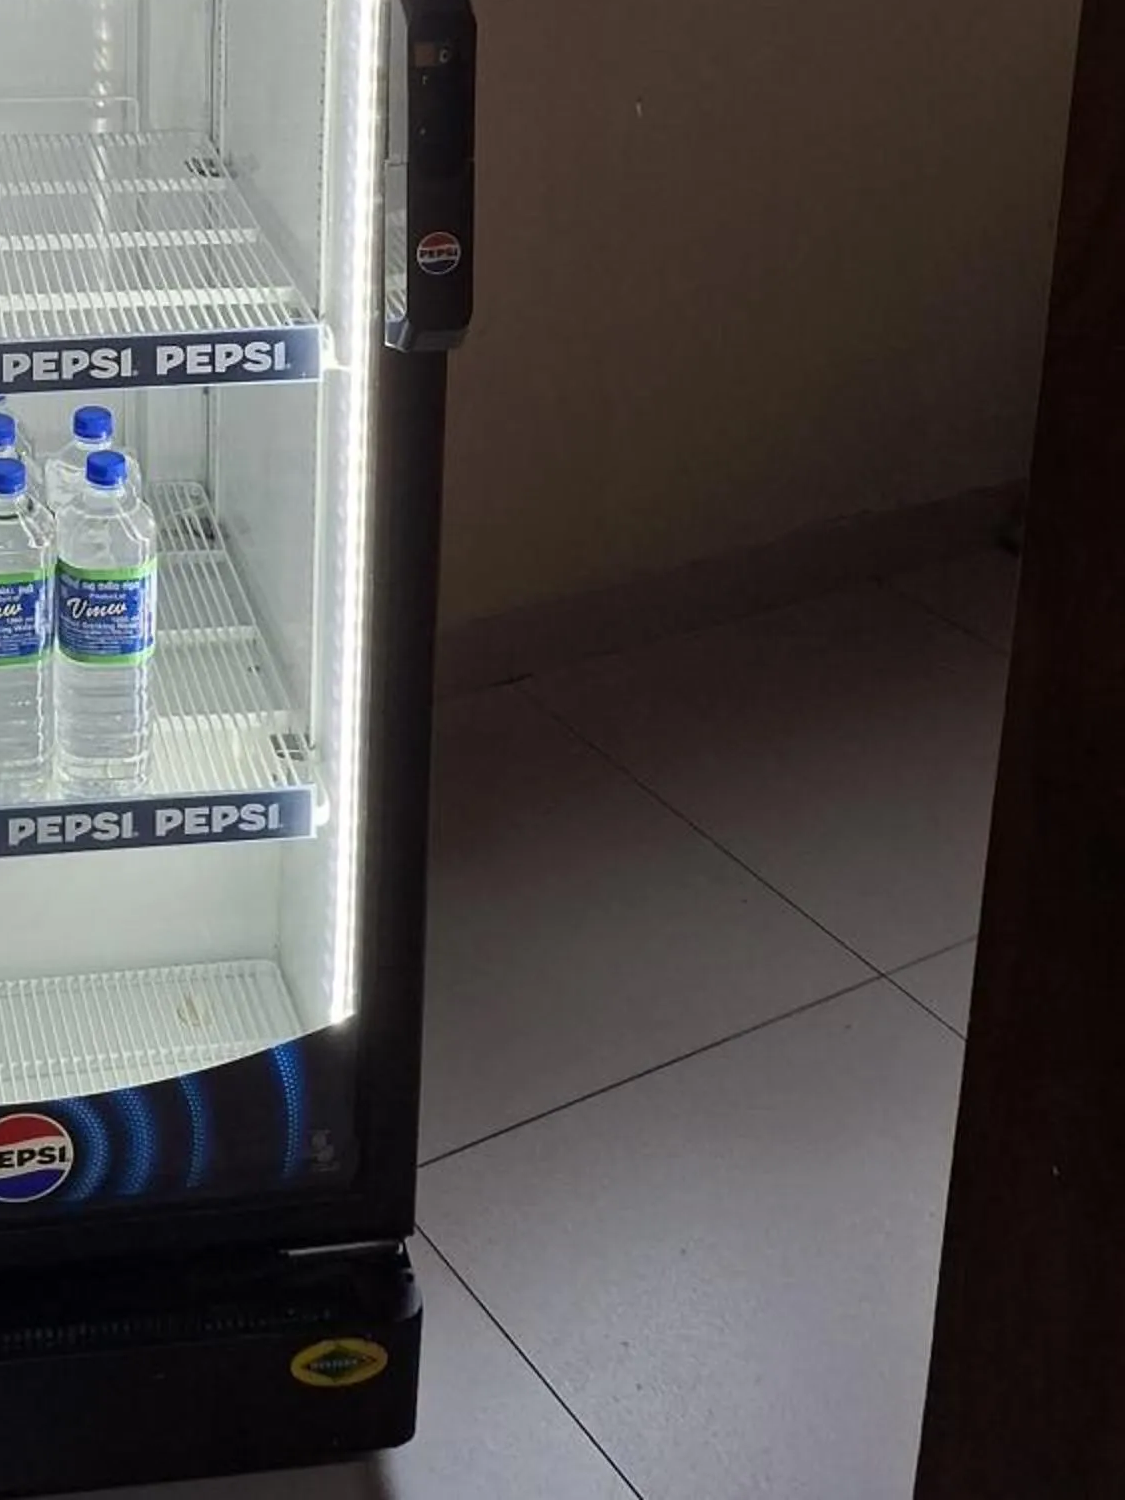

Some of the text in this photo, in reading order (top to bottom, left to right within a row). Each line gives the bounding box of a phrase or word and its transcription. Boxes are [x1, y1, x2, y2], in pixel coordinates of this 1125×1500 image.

[3, 348, 131, 382] PEPSI
[157, 341, 289, 375] PEPSI
[9, 812, 133, 845] PEPSI
[156, 803, 281, 836] PEPSI
